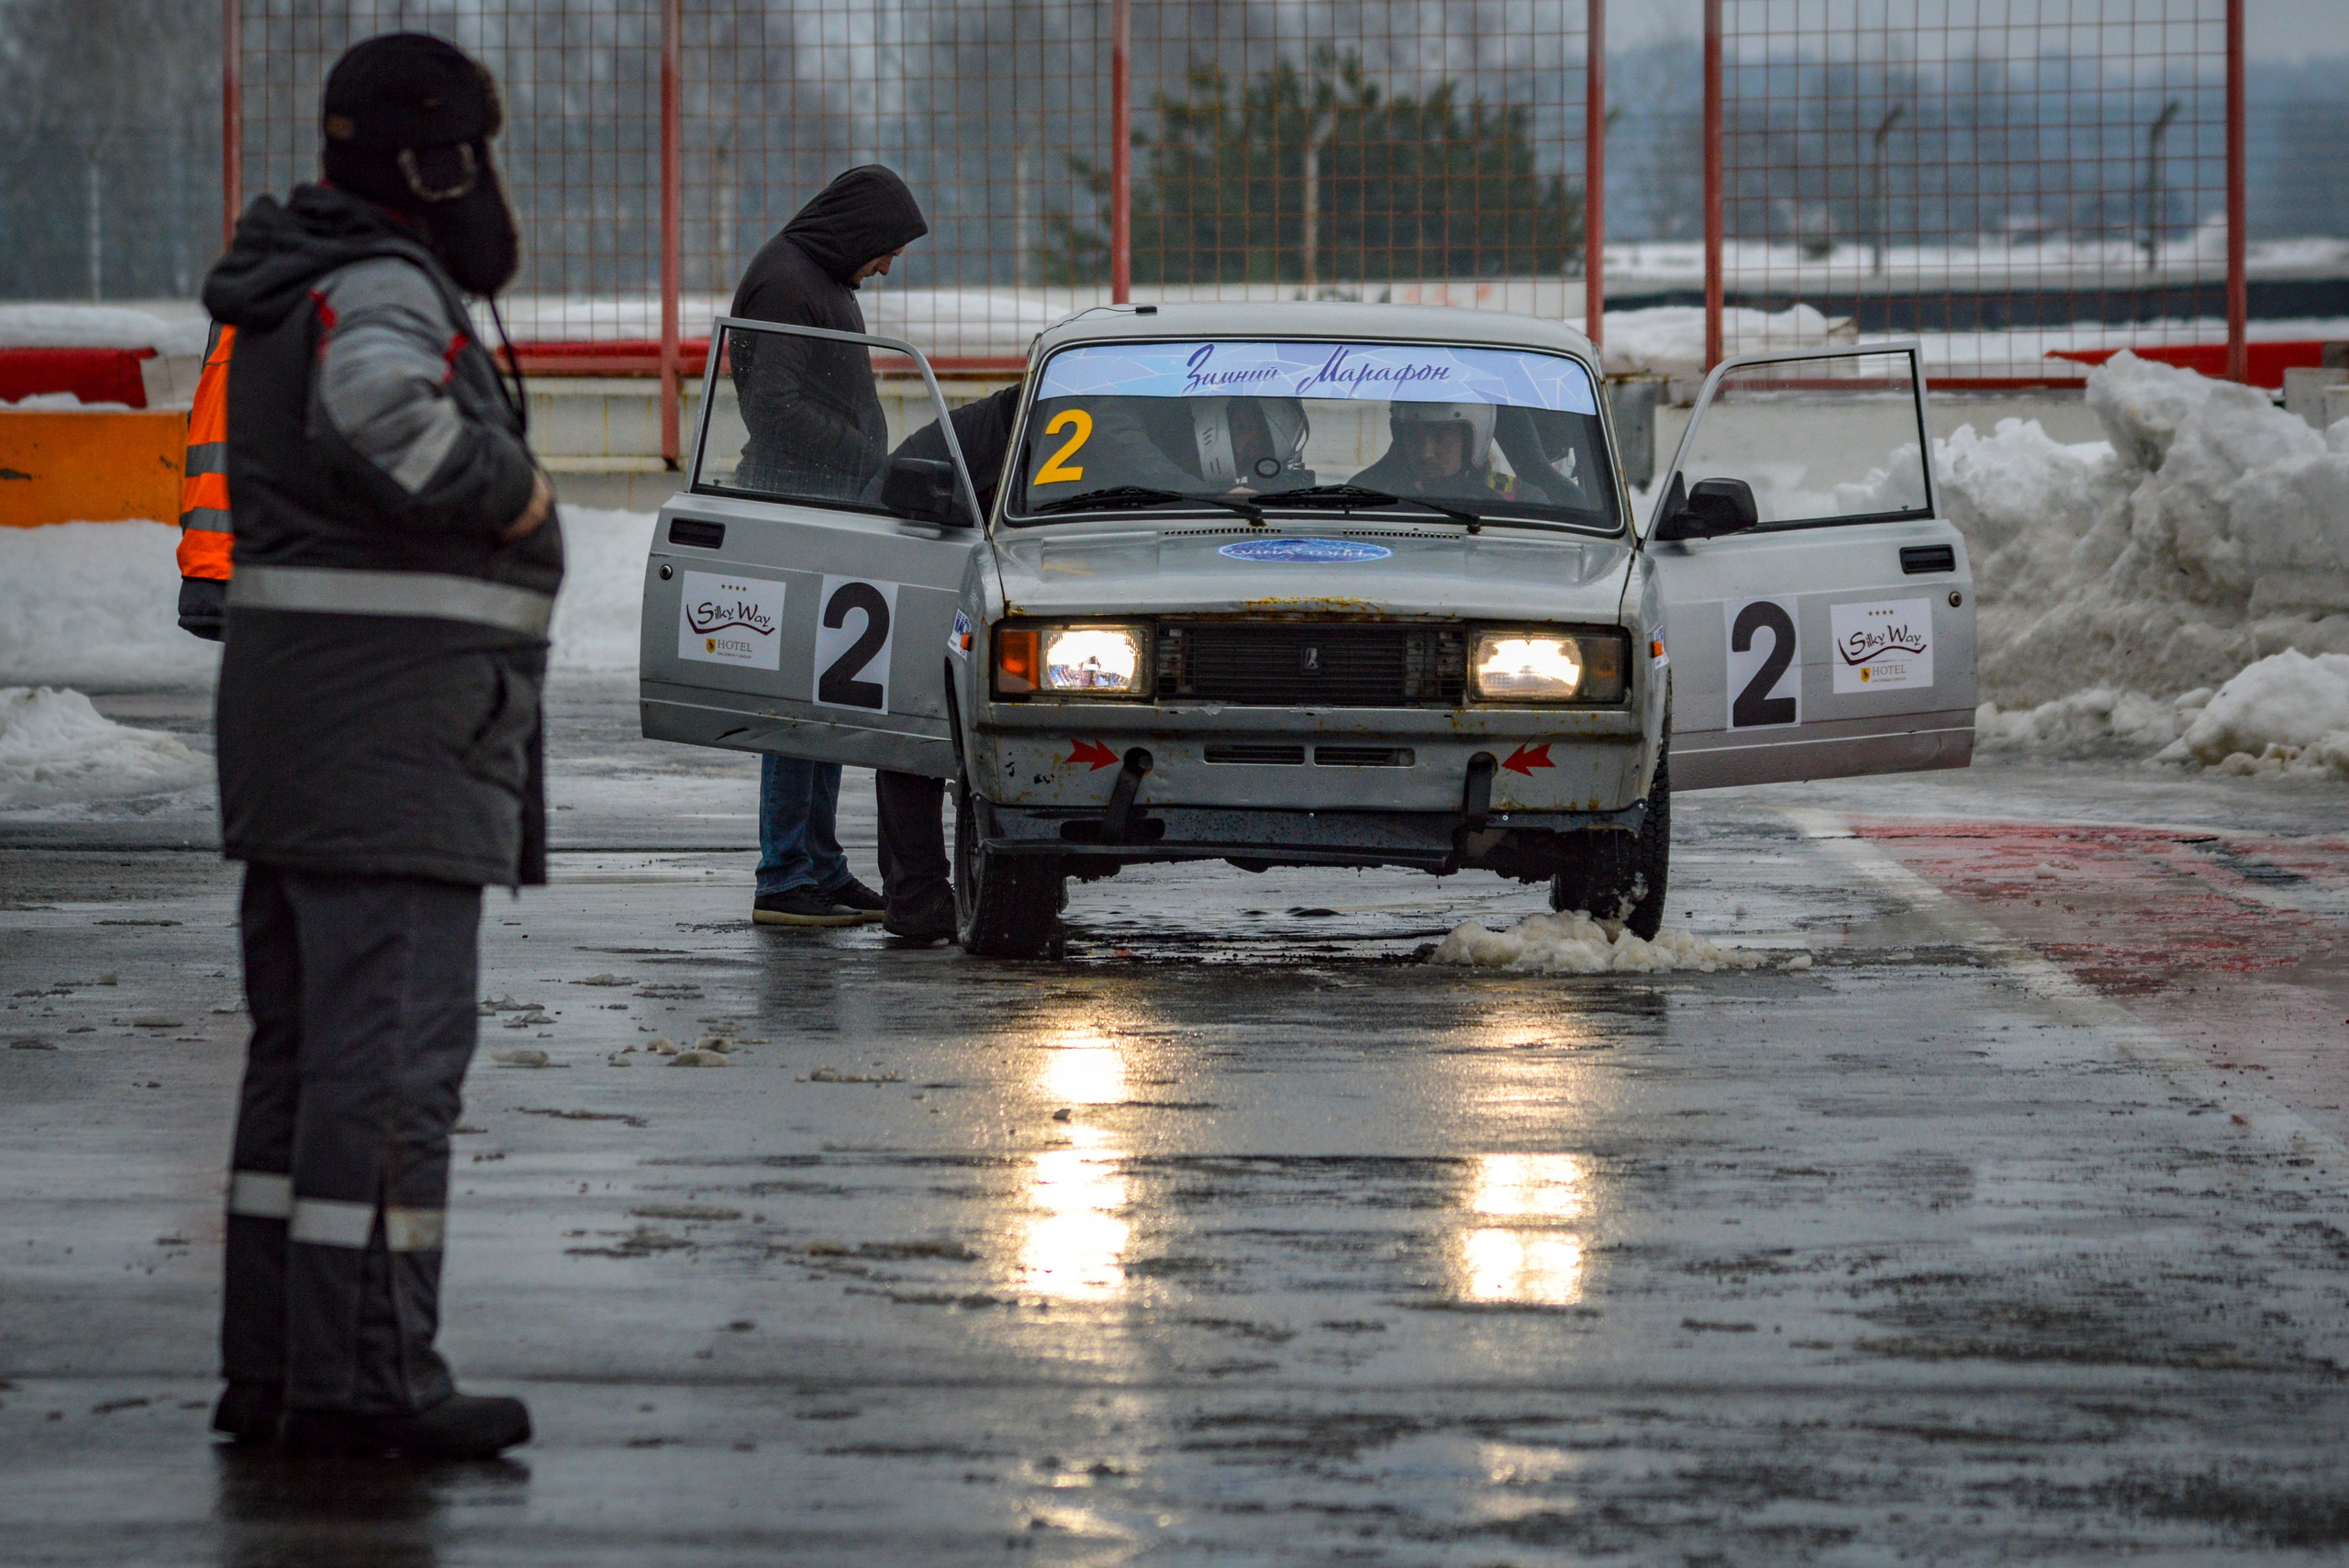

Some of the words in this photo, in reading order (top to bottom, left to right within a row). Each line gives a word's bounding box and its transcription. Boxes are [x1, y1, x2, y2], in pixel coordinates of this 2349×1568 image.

[1180, 343, 1278, 396] Зимний
[1296, 345, 1450, 399] Марафон
[1033, 409, 1094, 486] 2
[697, 602, 735, 626] Silky
[737, 601, 772, 628] Way
[718, 639, 752, 652] HOTEL
[818, 582, 890, 710] 2
[1850, 631, 1887, 656] Silky
[1887, 624, 1922, 646] Way
[1731, 600, 1797, 728] 2
[1872, 664, 1907, 676] HOTEL
